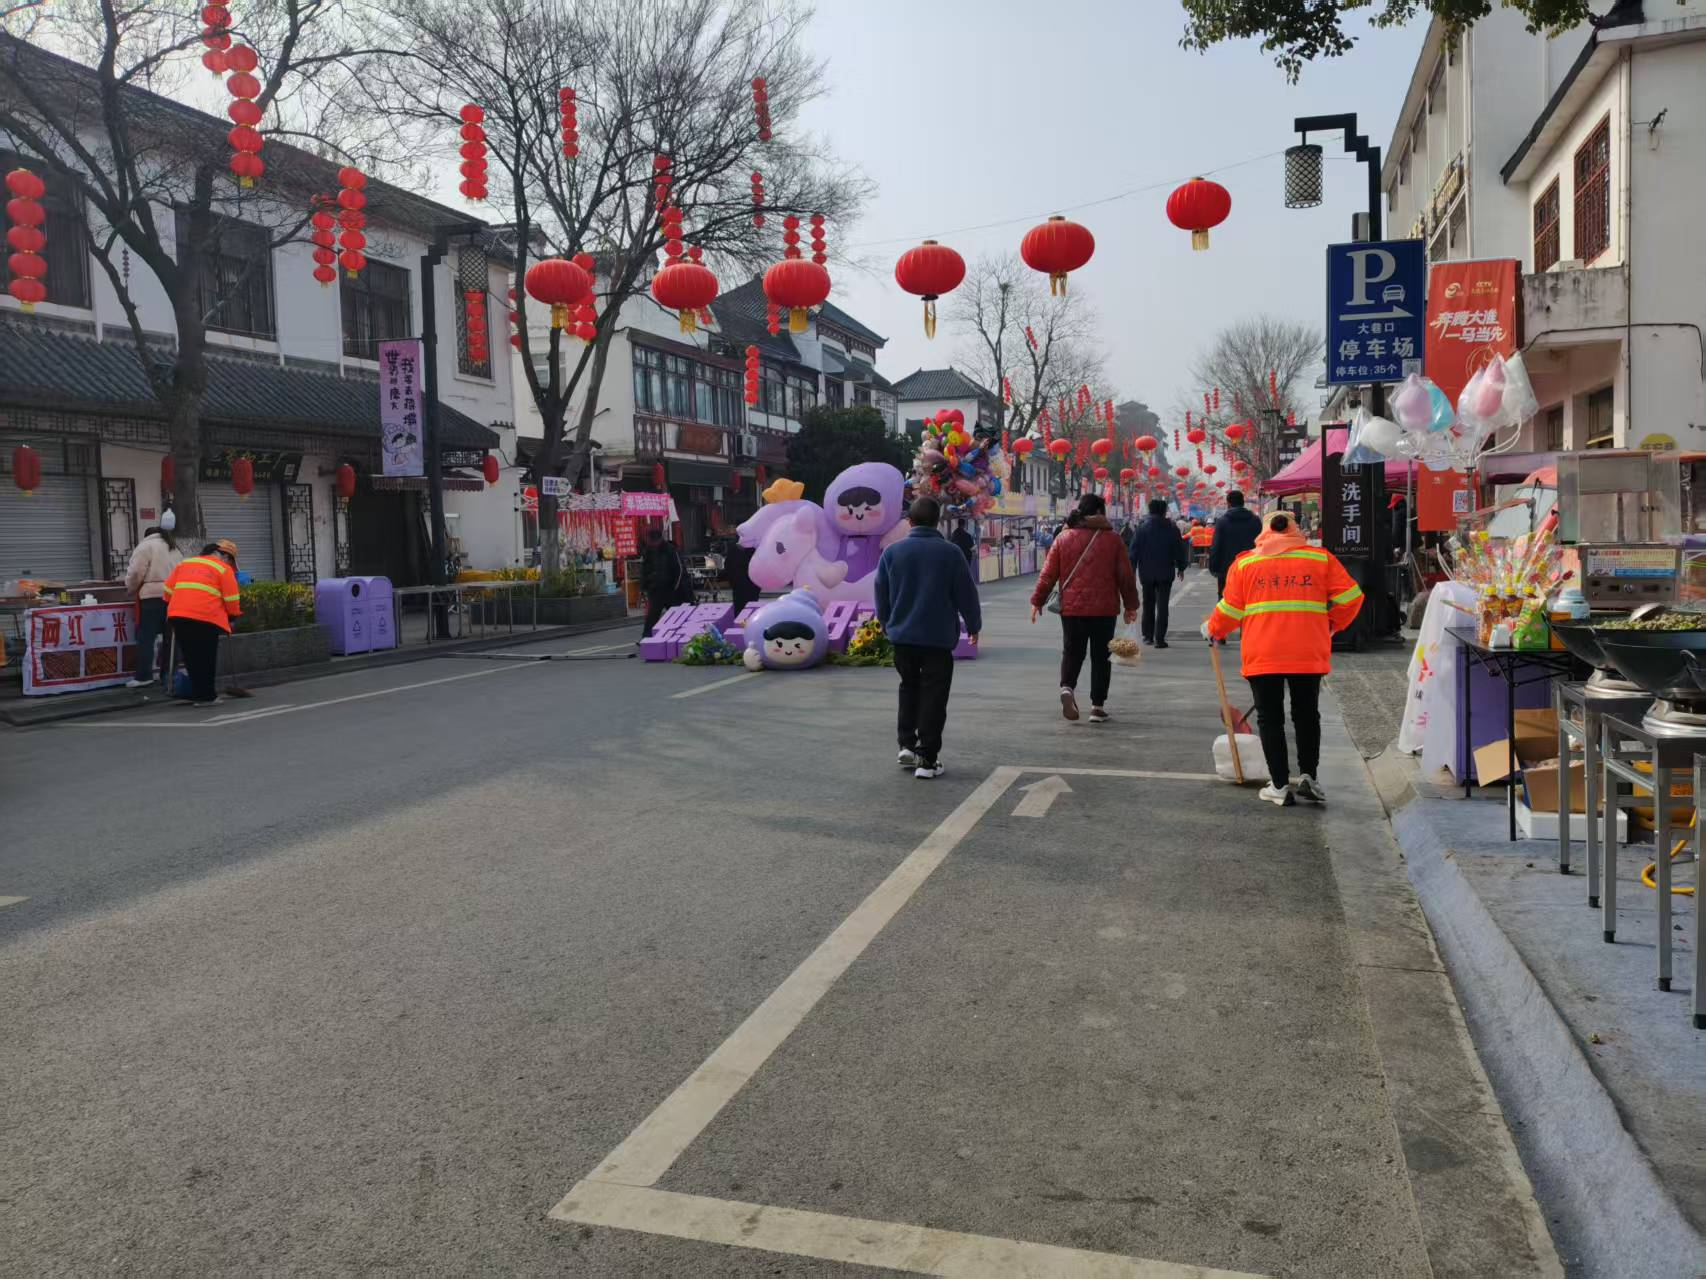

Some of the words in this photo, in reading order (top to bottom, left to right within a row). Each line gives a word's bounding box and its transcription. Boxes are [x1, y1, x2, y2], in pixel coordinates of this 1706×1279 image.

[1345, 248, 1397, 306] P
[1357, 322, 1395, 335] 大巷口
[1445, 326, 1508, 343] 一马当先
[1338, 336, 1415, 361] 停车场
[1340, 482, 1362, 545] 洗手间
[42, 612, 128, 648] 网红一米
